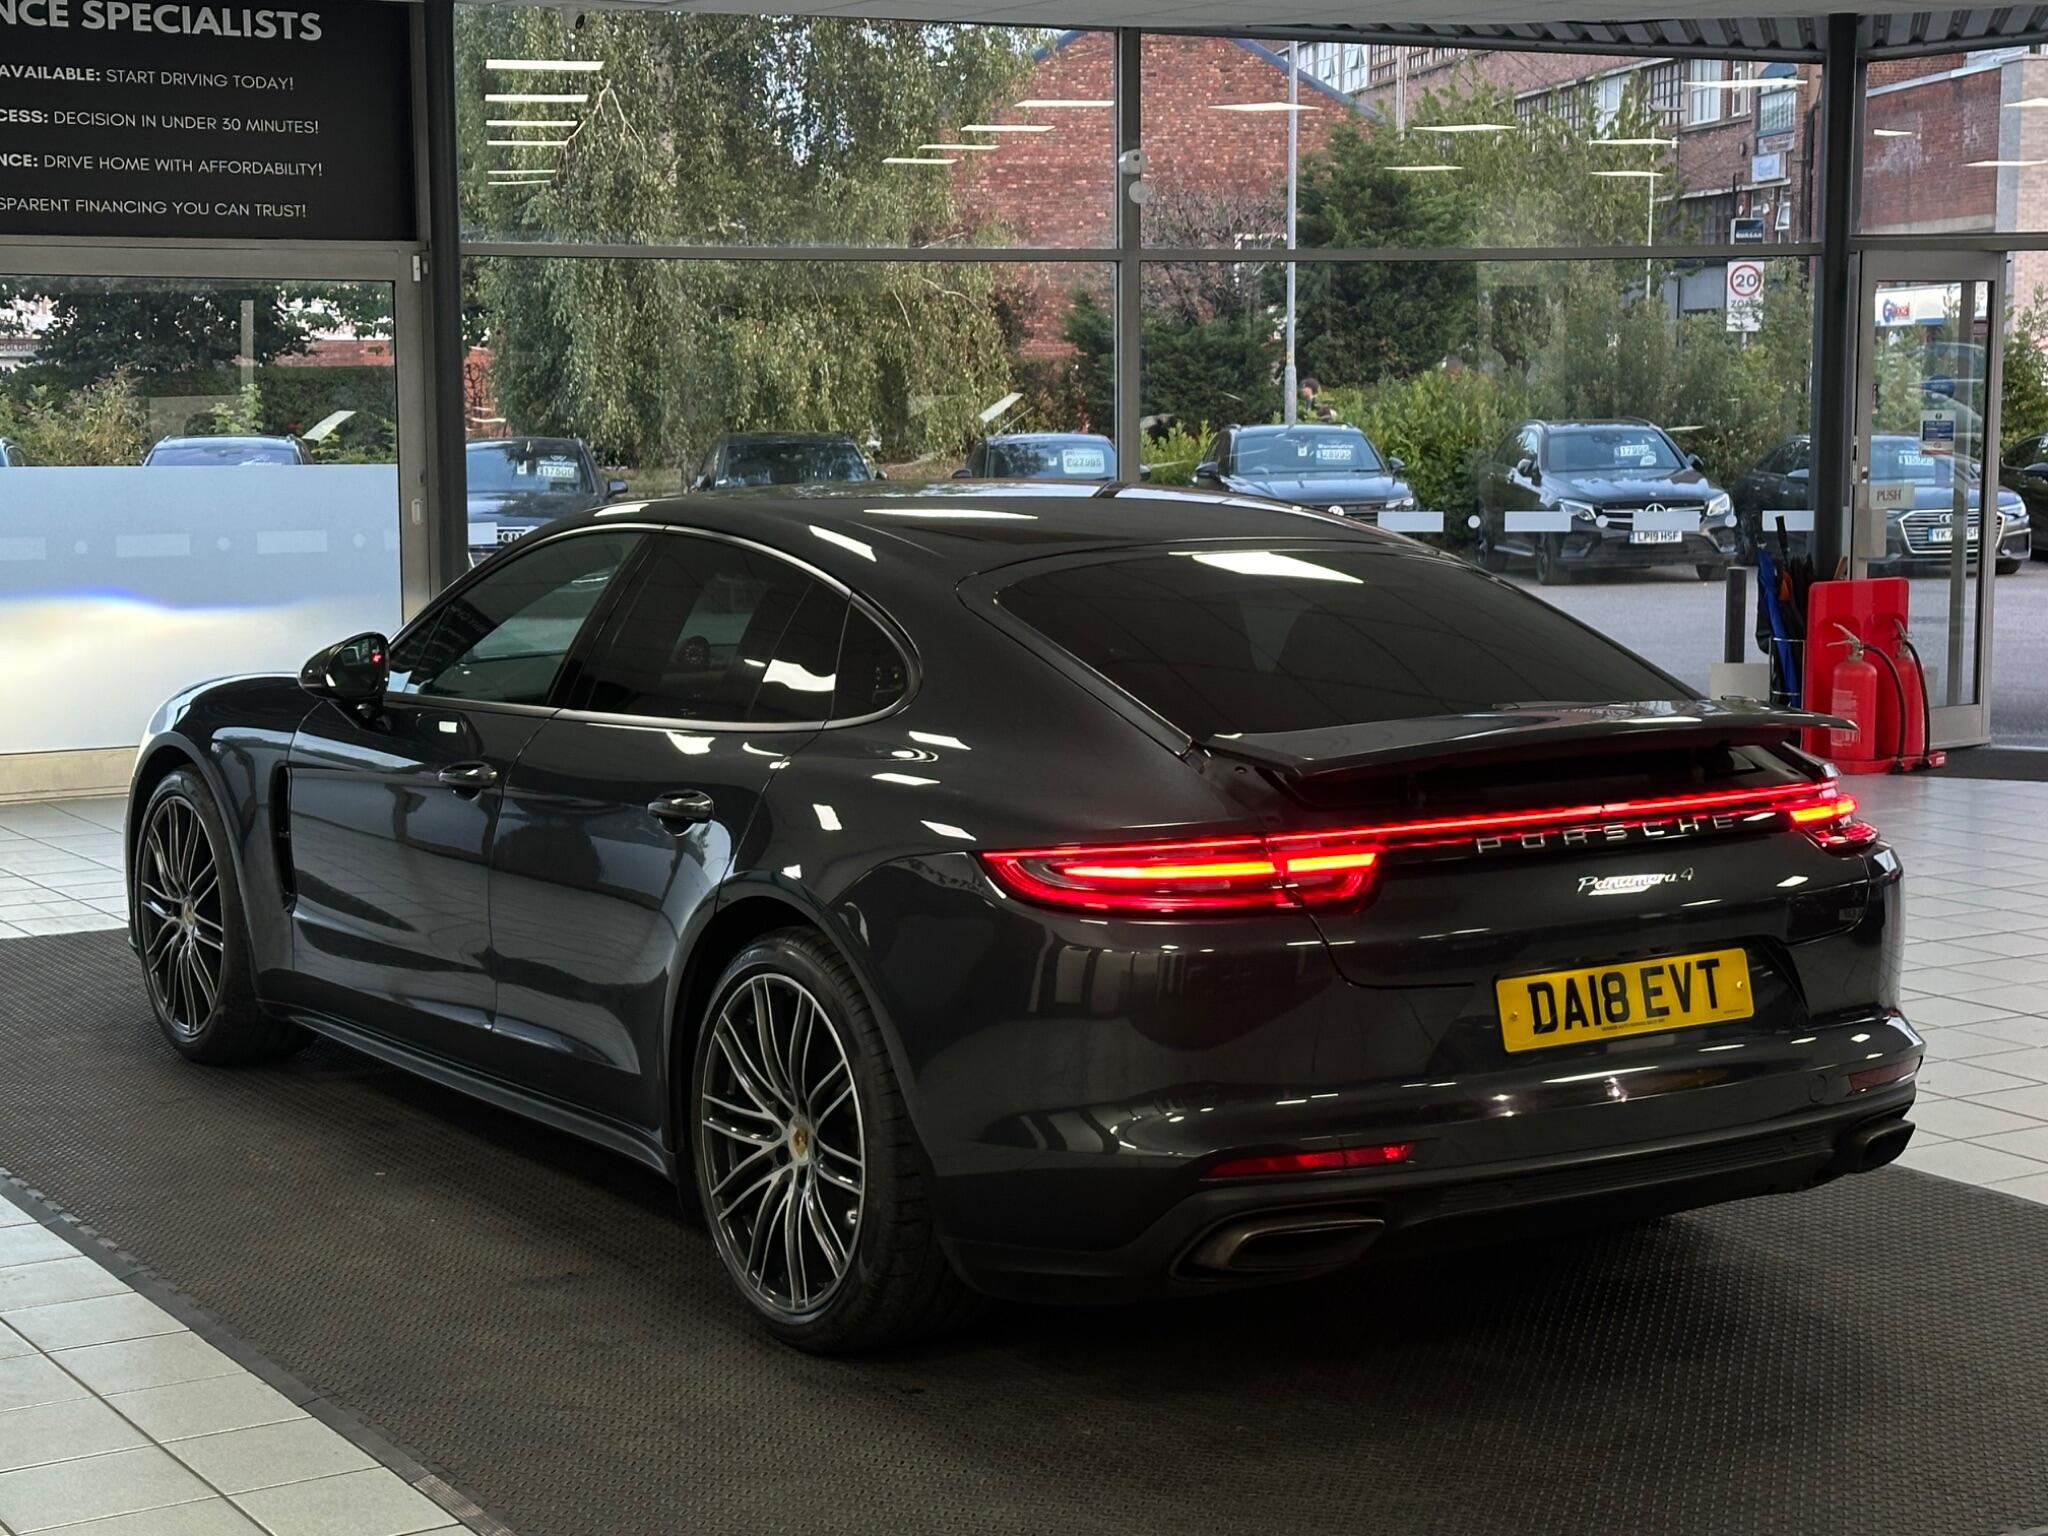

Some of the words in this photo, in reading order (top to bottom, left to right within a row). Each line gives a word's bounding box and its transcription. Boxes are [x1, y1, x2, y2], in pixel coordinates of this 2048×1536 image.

[81, 0, 322, 41] SPECIALISTS
[0, 64, 101, 82] AVAILABLE:
[106, 69, 156, 84] START
[160, 71, 228, 87] DRIVING
[232, 75, 294, 91] TODAY!
[0, 108, 49, 123] CESS:
[54, 111, 136, 127] DECISION
[141, 114, 157, 128] IN
[161, 115, 217, 130] UNDER
[222, 117, 242, 131] 30
[246, 119, 319, 134] MINUTES!
[44, 154, 94, 169] DRIVE
[99, 156, 150, 171] HOME
[154, 158, 193, 172] WITH
[198, 160, 322, 177] AFFORDABILITY!
[75, 199, 168, 215] FINANCING
[172, 202, 210, 215] YOU
[214, 203, 250, 217] CAN
[254, 203, 306, 219] TRUST!
[1735, 274, 1757, 288] 20
[1876, 488, 1902, 502] PUSH
[1476, 814, 1733, 853] PORSCHE
[1577, 873, 1677, 893] Panamera
[1680, 867, 1694, 881] 4
[1527, 971, 1630, 1034] DA18
[1639, 958, 1720, 1018] EVT
